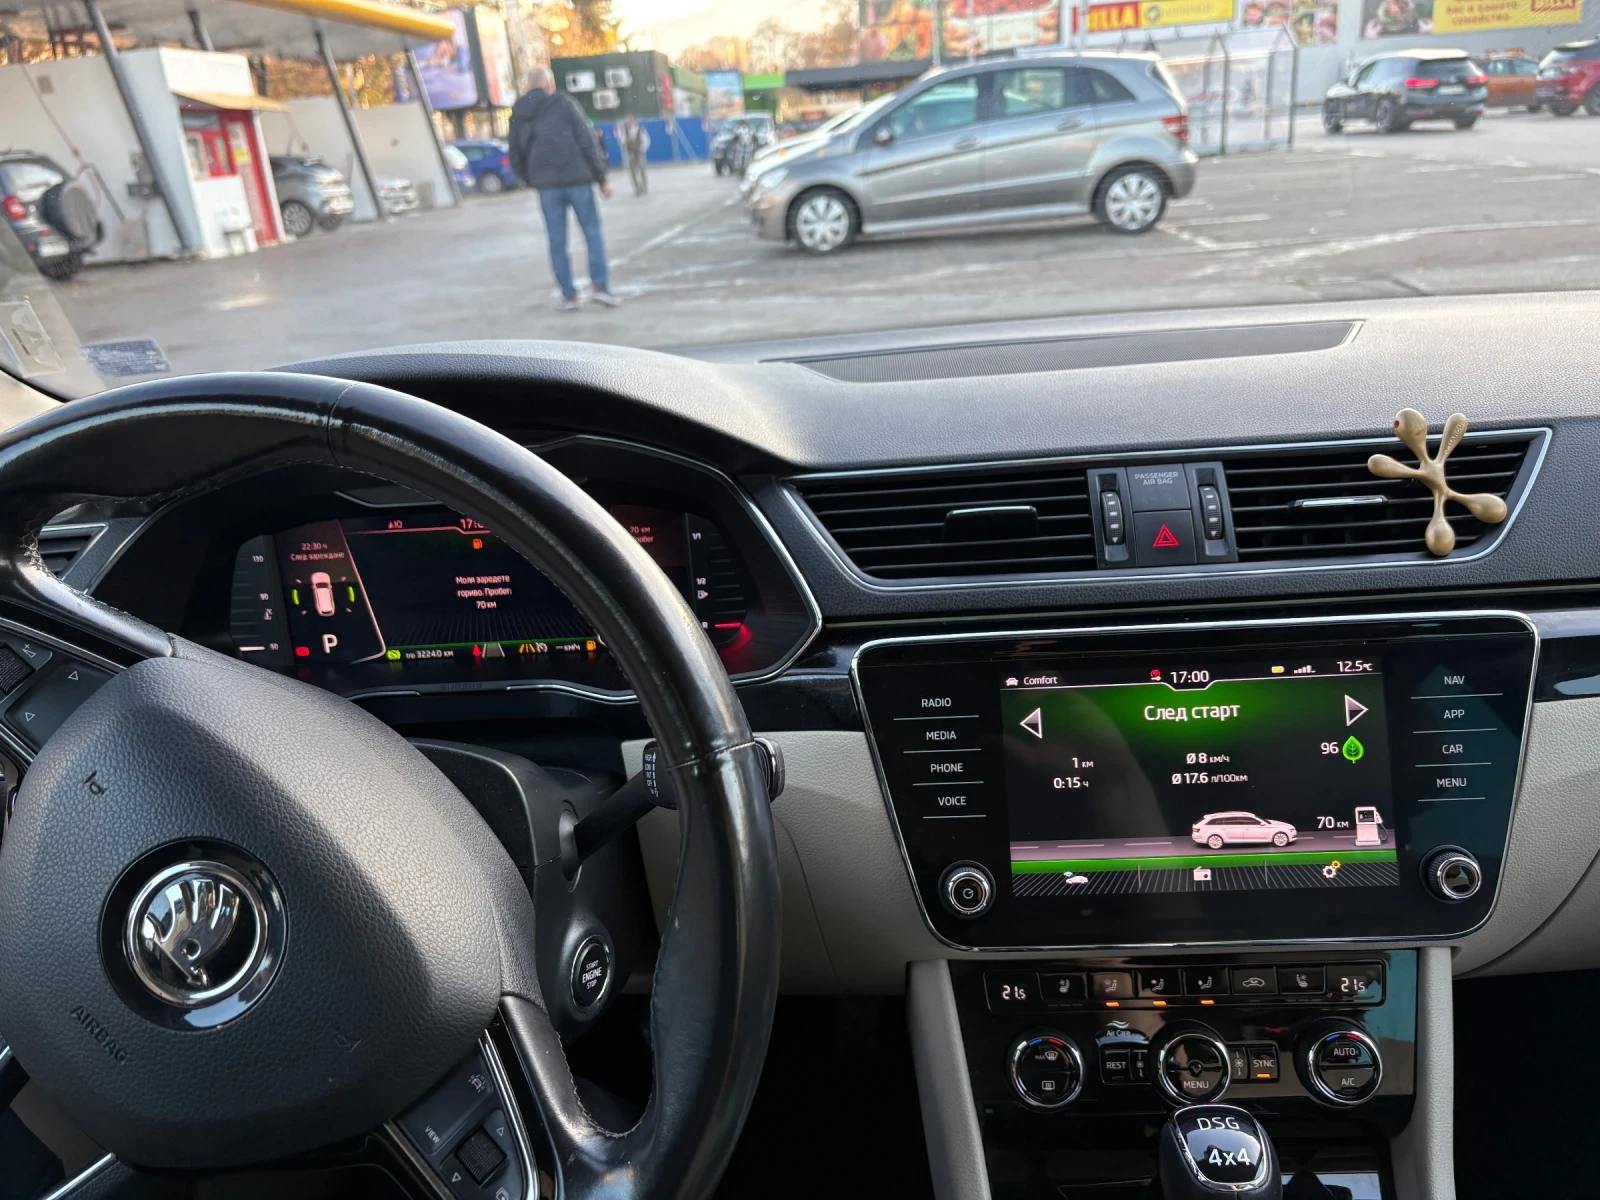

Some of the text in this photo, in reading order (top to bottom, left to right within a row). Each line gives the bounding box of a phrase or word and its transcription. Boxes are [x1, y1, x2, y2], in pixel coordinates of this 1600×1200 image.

[455, 574, 510, 585] Моля заредете
[476, 600, 497, 609] 70 км
[702, 621, 709, 629] R
[321, 634, 338, 654] P
[1023, 676, 1058, 686] Comfort
[1170, 670, 1210, 684] 17:00
[1444, 675, 1465, 685] NAV
[921, 697, 952, 708] RADIO
[1144, 703, 1240, 723] След старт
[1443, 709, 1465, 719] APP
[926, 731, 957, 741] MEDIA
[1320, 742, 1339, 755] 96
[1442, 744, 1464, 754] CAR
[1071, 757, 1094, 769] 1 км
[1198, 752, 1208, 764] 8
[1209, 754, 1230, 763] км/ч
[930, 763, 964, 773] PHONE
[1053, 776, 1081, 789] 0:15
[1183, 772, 1209, 784] 17.6
[1436, 778, 1467, 788] MENU
[937, 796, 967, 806] VOICE
[1316, 816, 1335, 830] 70
[586, 959, 599, 971] START
[582, 966, 603, 983] ENGINE
[586, 979, 598, 990] STOP
[70, 1005, 128, 1062] AIRBAG
[1106, 1029, 1115, 1037] Air
[1333, 1047, 1356, 1056] AUTO
[1106, 1061, 1127, 1069] REST
[1253, 1059, 1275, 1068] SYNC
[1183, 1080, 1209, 1089] MENU
[1341, 1077, 1356, 1086] A/C
[1196, 1116, 1240, 1131] DSG
[424, 1125, 441, 1144] VIEW
[1208, 1148, 1251, 1167] 4x4
